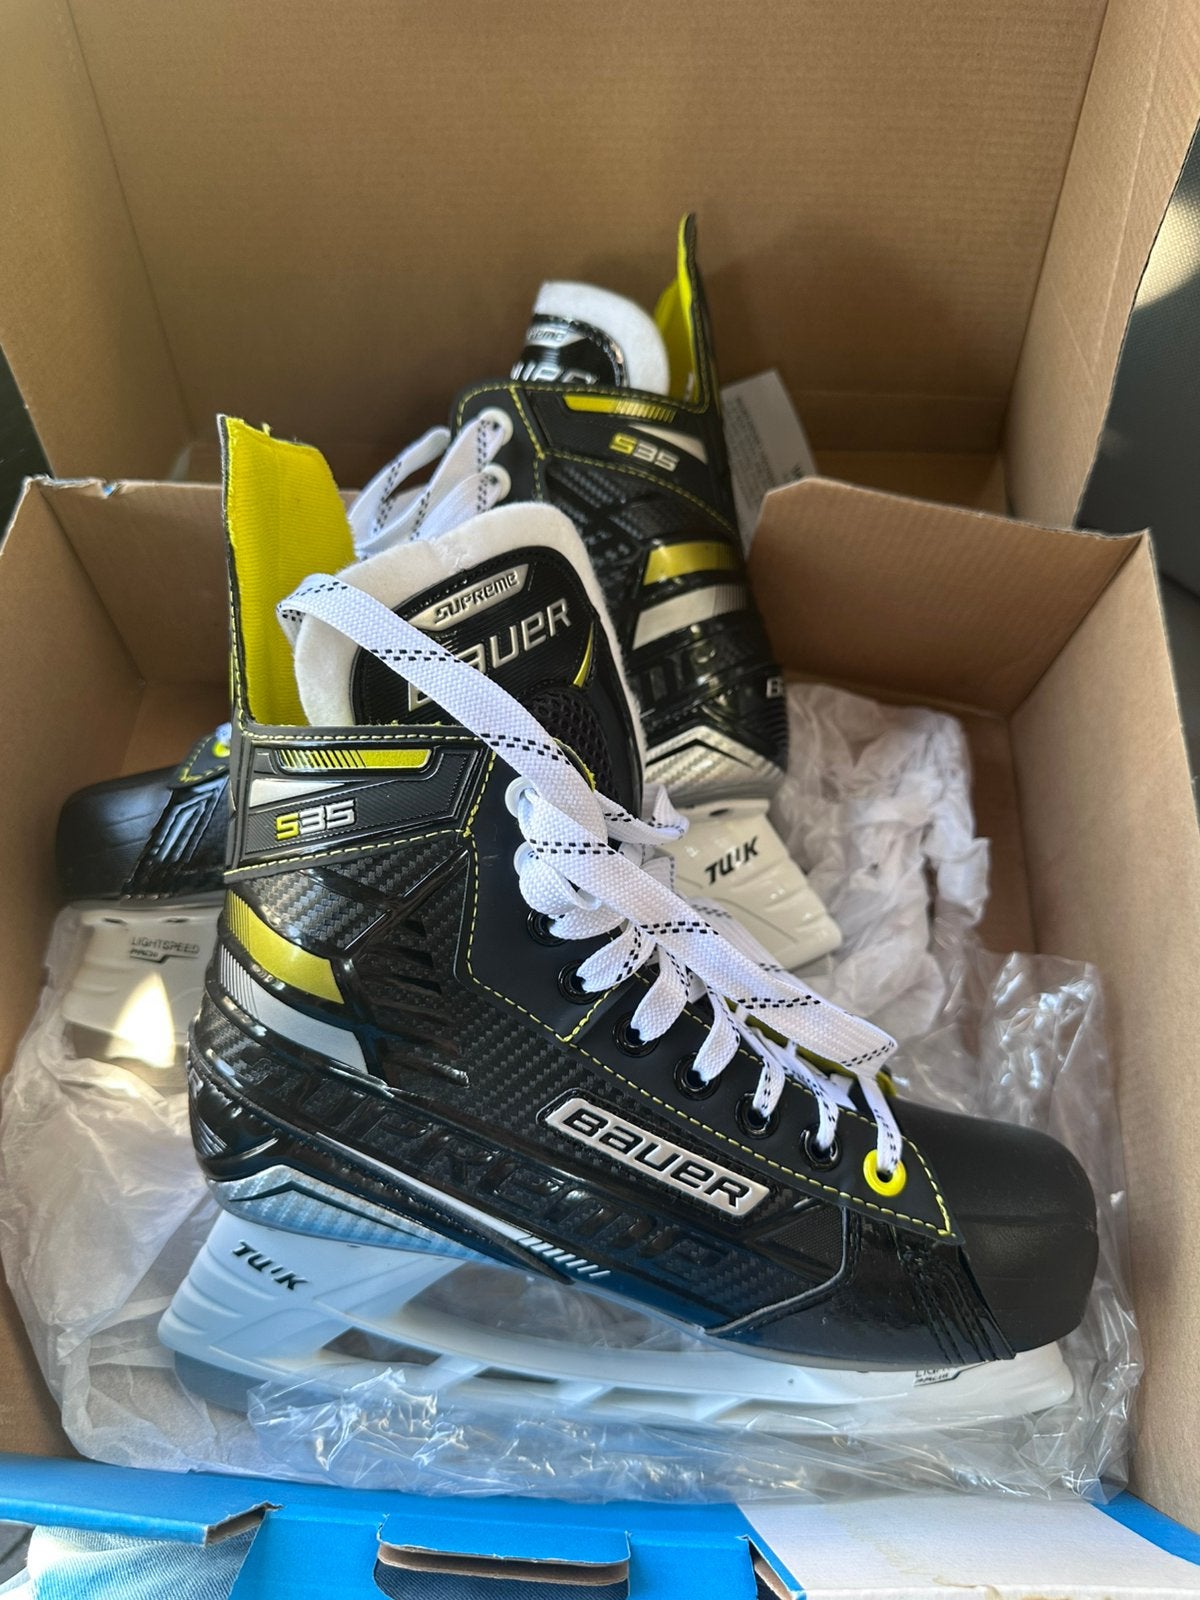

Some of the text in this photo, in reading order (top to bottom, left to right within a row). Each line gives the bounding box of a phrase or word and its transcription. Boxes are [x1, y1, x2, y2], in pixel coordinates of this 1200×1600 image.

[609, 433, 679, 471] S35
[434, 570, 520, 625] SUPREME
[408, 598, 572, 712] AUER
[276, 799, 356, 841] S35
[130, 936, 200, 954] LIGHTSPEED
[562, 1107, 751, 1208] BAUER
